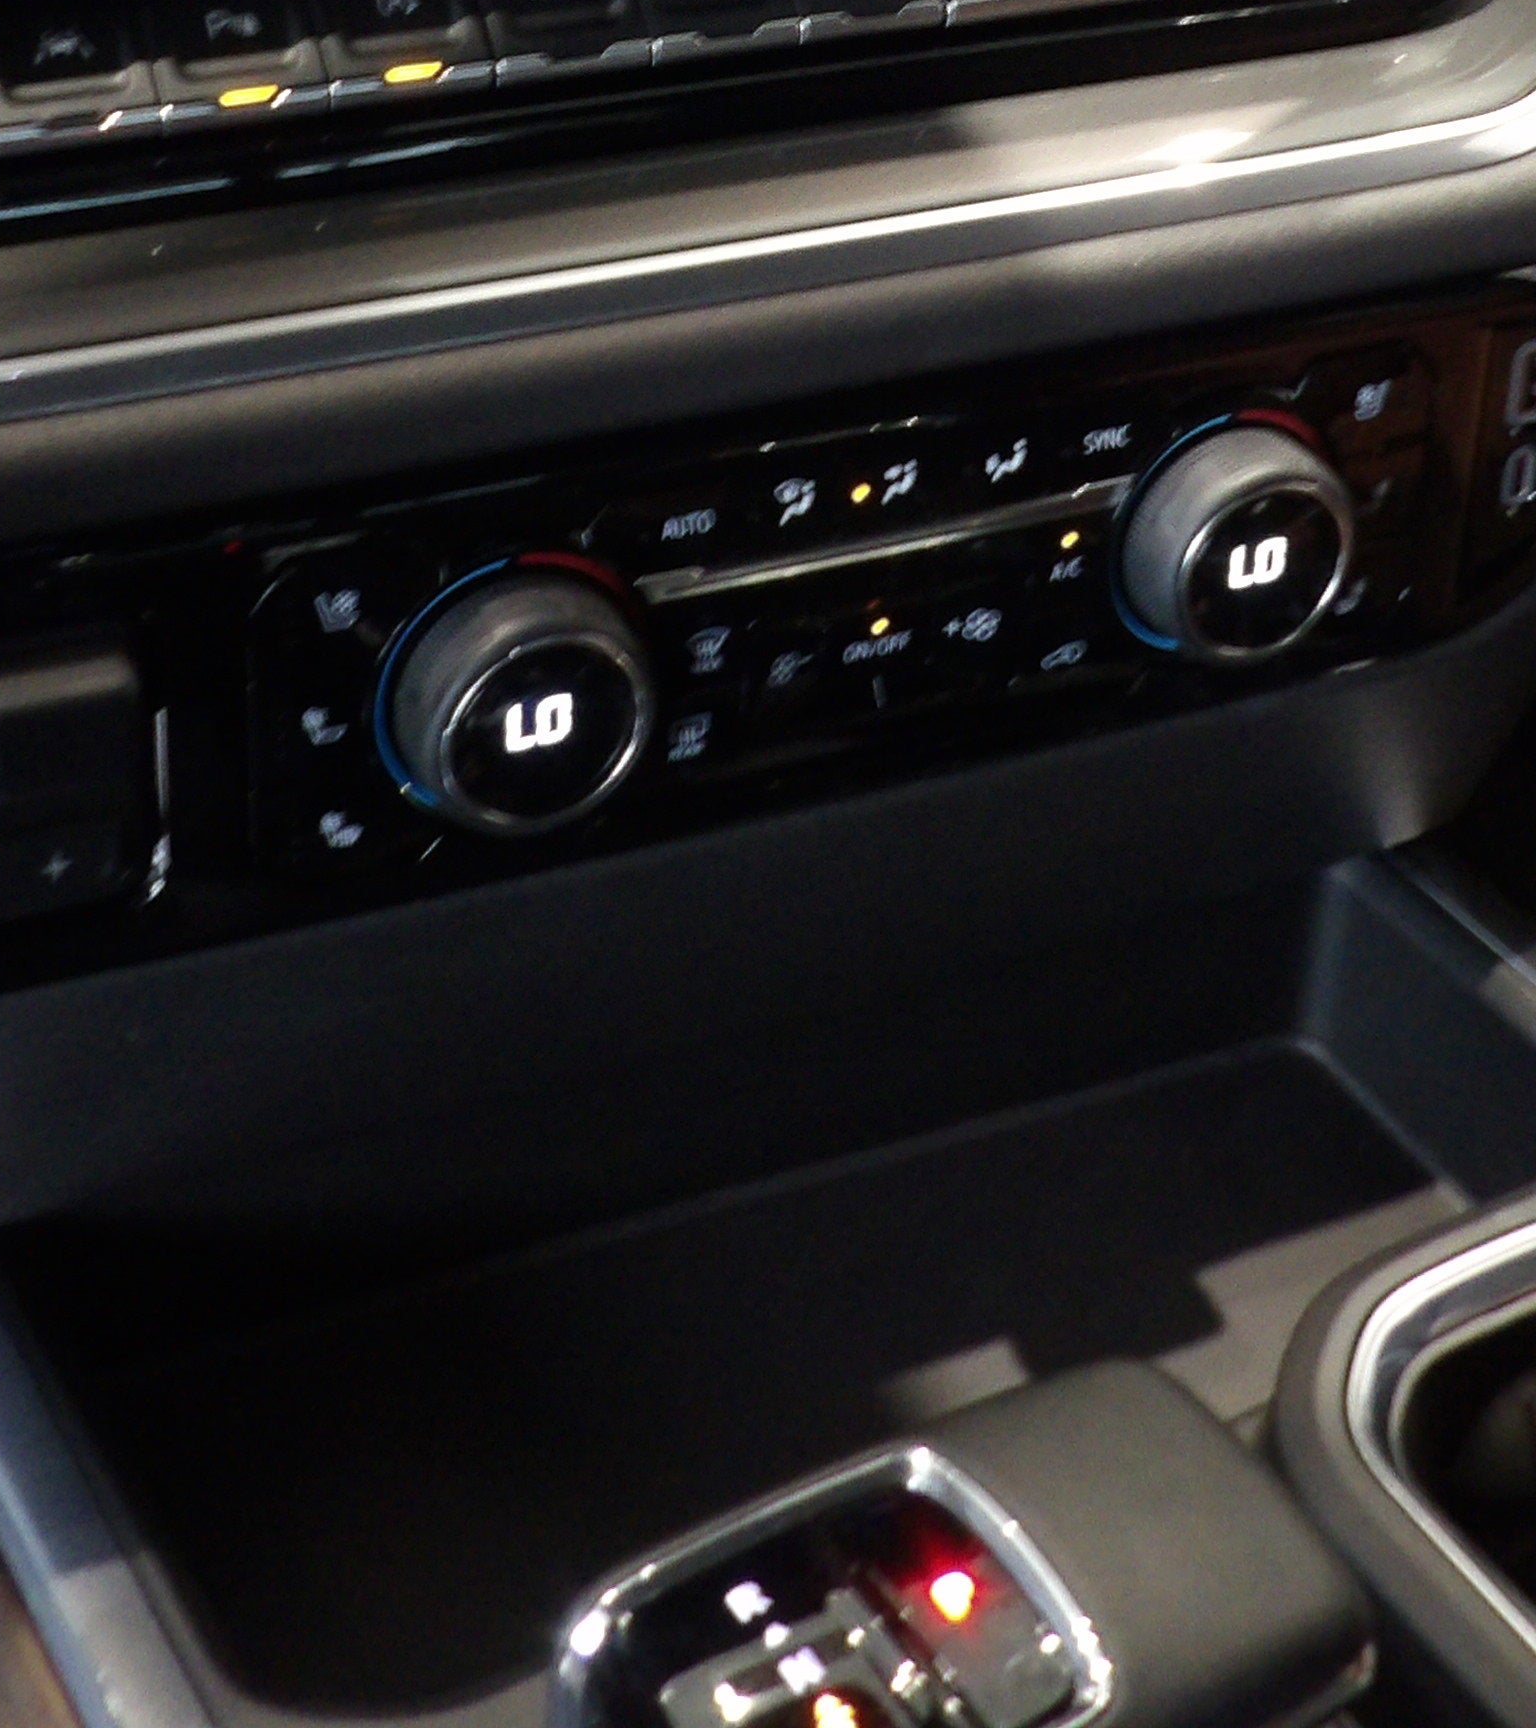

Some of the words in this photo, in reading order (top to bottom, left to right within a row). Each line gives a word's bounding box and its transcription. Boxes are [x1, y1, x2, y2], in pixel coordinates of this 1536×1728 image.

[1083, 423, 1131, 456] SYNC
[661, 508, 717, 541] AUTO
[842, 629, 914, 665] ON/OFF
